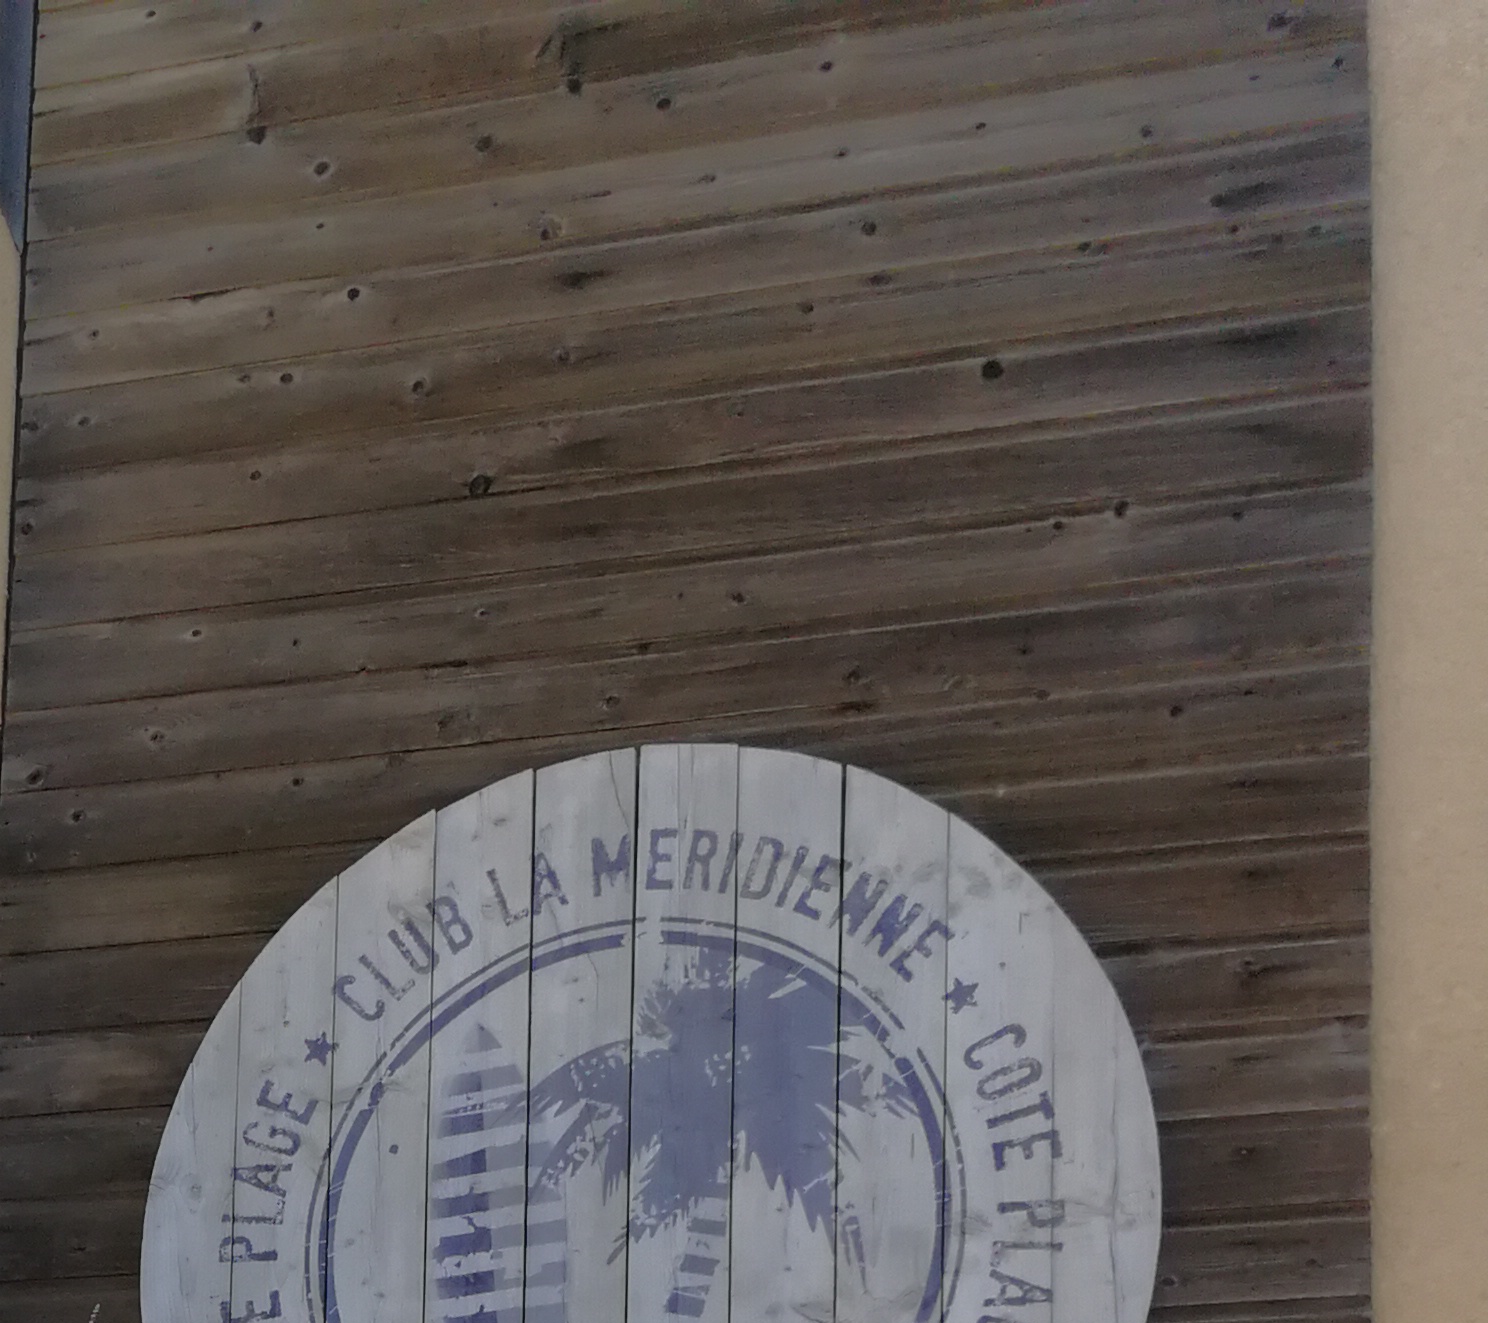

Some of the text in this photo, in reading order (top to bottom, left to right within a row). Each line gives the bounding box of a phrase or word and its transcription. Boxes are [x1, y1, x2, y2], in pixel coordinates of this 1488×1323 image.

[332, 827, 956, 1022] CLUB LA MERIDIENNE
[218, 1078, 319, 1263] PLAGE
[962, 1022, 1064, 1172] COTE
